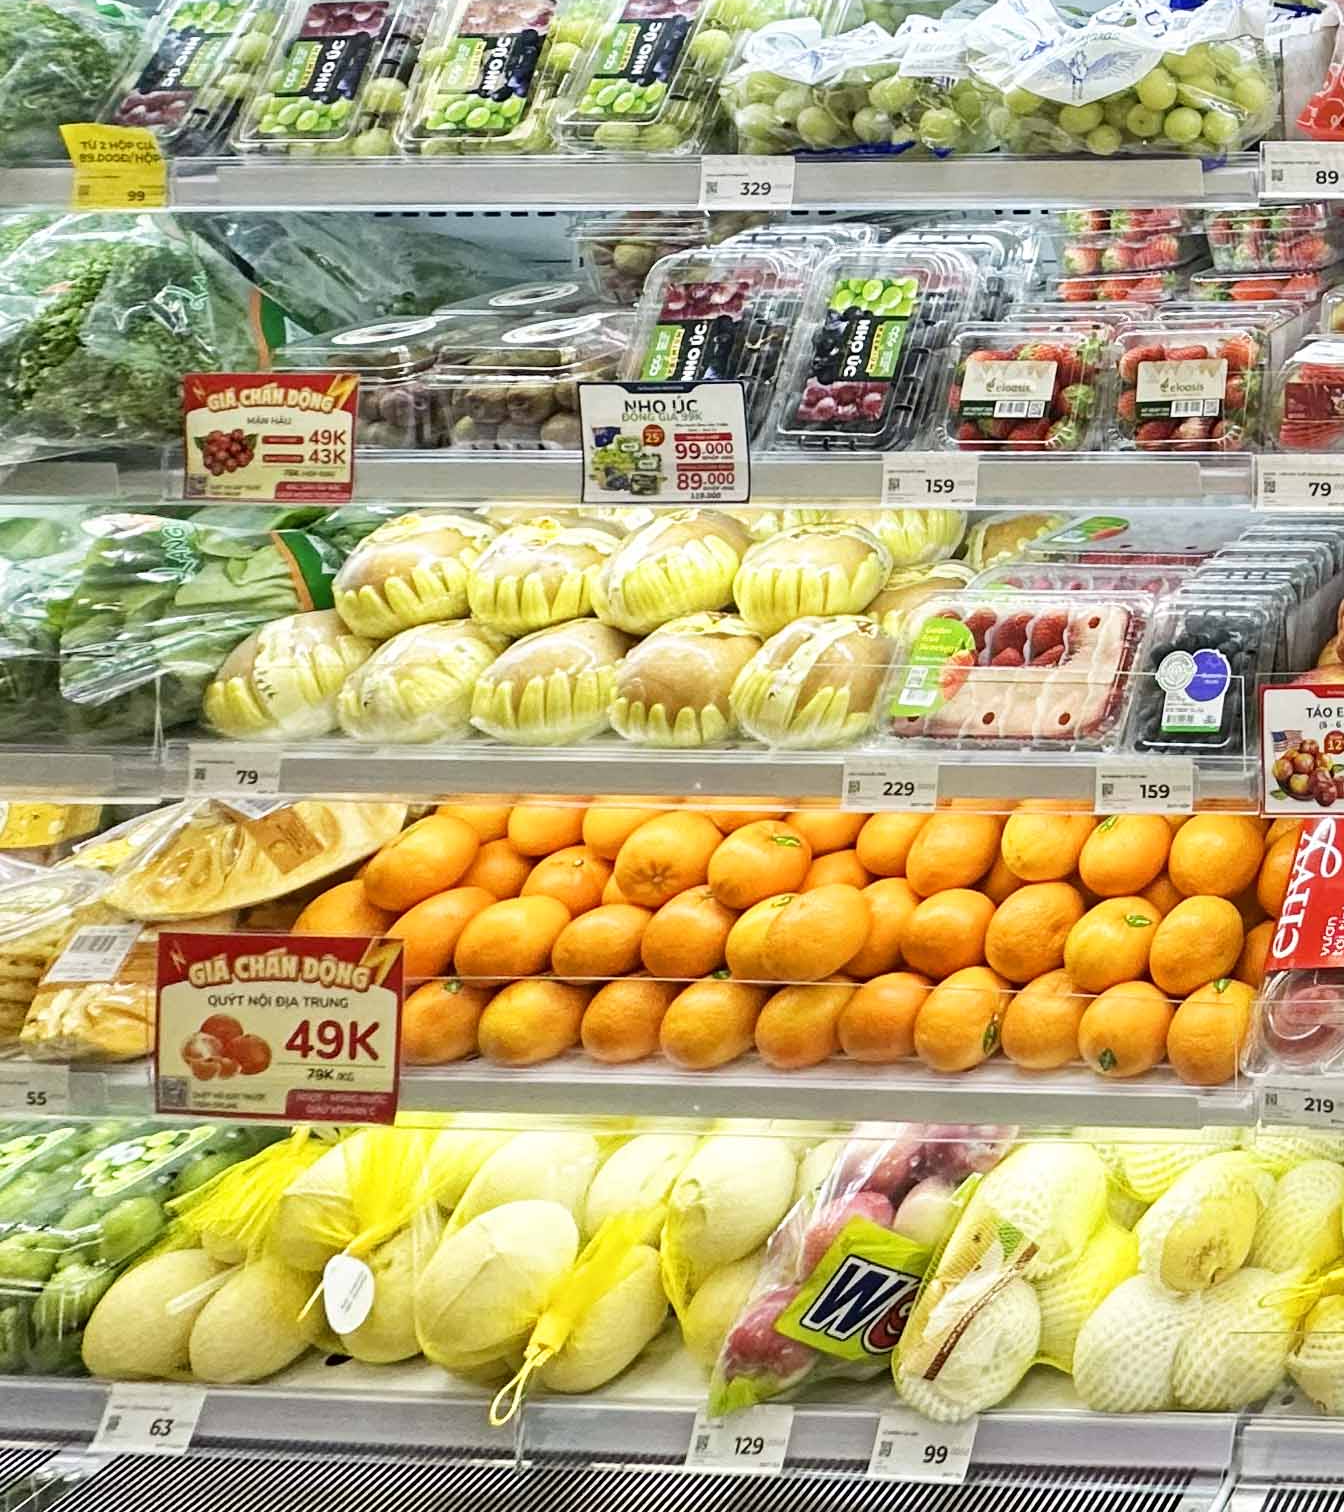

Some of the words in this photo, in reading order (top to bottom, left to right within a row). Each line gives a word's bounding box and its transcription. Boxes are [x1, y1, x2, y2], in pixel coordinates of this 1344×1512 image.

[1315, 170, 1339, 185] 89
[127, 189, 146, 203] 99
[740, 181, 772, 196] 329
[207, 389, 238, 411] GIÁ
[240, 382, 285, 406] CHẤN
[287, 389, 336, 413] ĐỘNG
[625, 400, 665, 414] NHO
[309, 430, 346, 446] 49K
[309, 449, 346, 465] 43K
[675, 443, 734, 460] 99.000
[677, 473, 735, 491] 89.000
[925, 479, 955, 494] 159
[1308, 482, 1332, 497] 79
[1306, 704, 1332, 718] TÁO
[236, 769, 259, 785] 79
[882, 781, 915, 797] 229
[1139, 784, 1170, 799] 159
[1272, 818, 1343, 959] envy
[189, 953, 232, 987] GIÁ
[235, 947, 300, 983] CHẤN
[301, 954, 371, 992] ĐỘNG
[208, 993, 244, 1008] QUÝT
[248, 994, 272, 1008] NỘI
[276, 995, 299, 1009] ĐỊA
[303, 996, 349, 1009] TRUNG
[285, 1020, 380, 1061] 49K
[26, 1091, 47, 1106] 55
[1304, 1097, 1334, 1114] 219
[149, 1418, 175, 1437] 63
[735, 1436, 764, 1455] 129
[922, 1444, 948, 1465] 99
